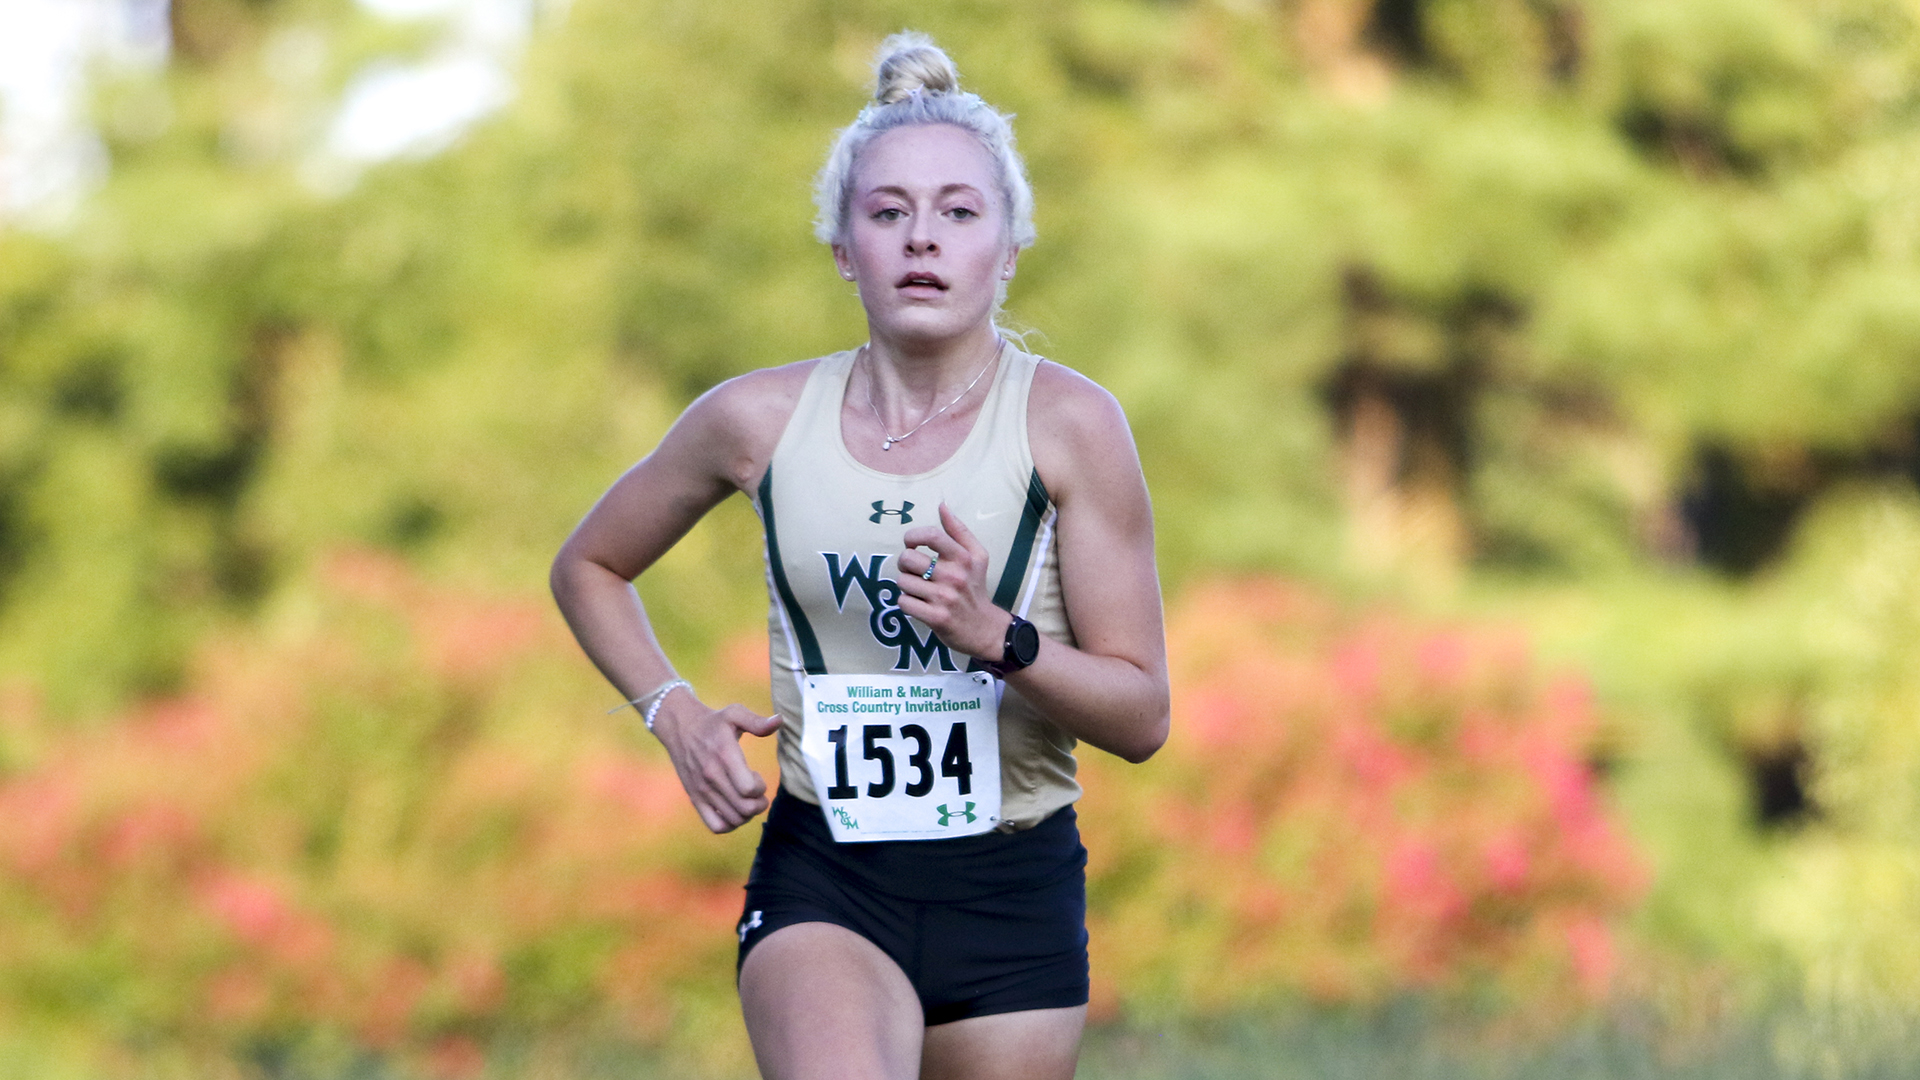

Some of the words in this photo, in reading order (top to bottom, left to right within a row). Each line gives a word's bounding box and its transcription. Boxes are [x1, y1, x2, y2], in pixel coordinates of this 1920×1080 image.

[847, 686, 893, 698] William
[897, 686, 906, 698] &
[910, 686, 943, 700] Mary
[817, 701, 848, 713] Cross
[852, 701, 901, 715] Country
[905, 698, 981, 713] Invitational
[827, 721, 973, 800] 1534
